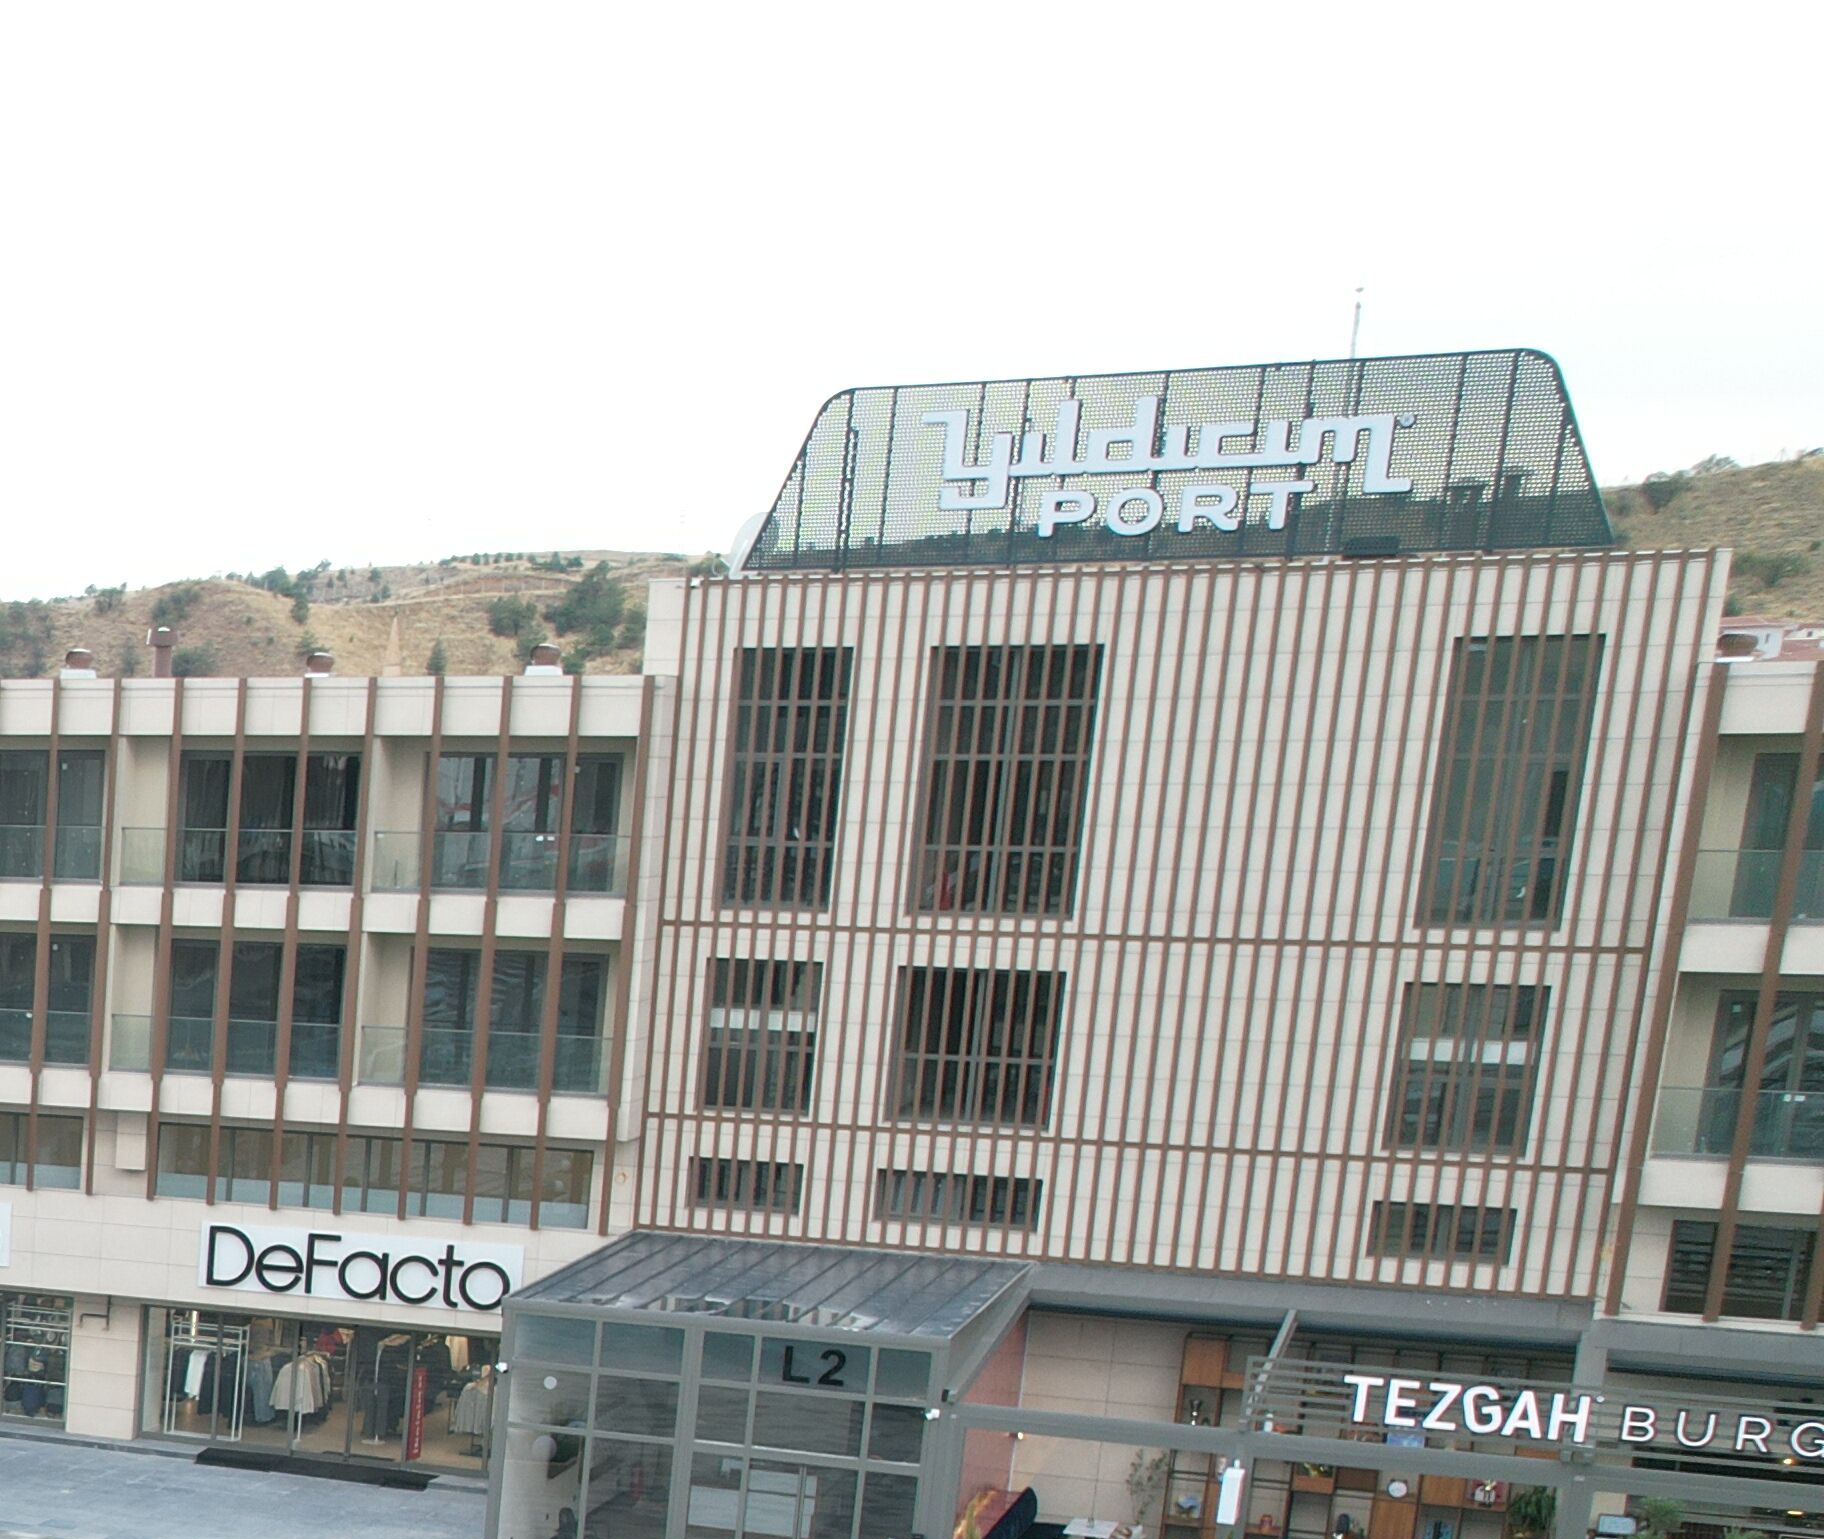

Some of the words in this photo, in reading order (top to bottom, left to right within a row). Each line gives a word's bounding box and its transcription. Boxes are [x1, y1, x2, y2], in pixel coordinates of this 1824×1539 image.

[1038, 480, 1315, 538] PORT
[205, 1225, 511, 1311] DeFacto
[1342, 1375, 1592, 1444] TEZGAH
